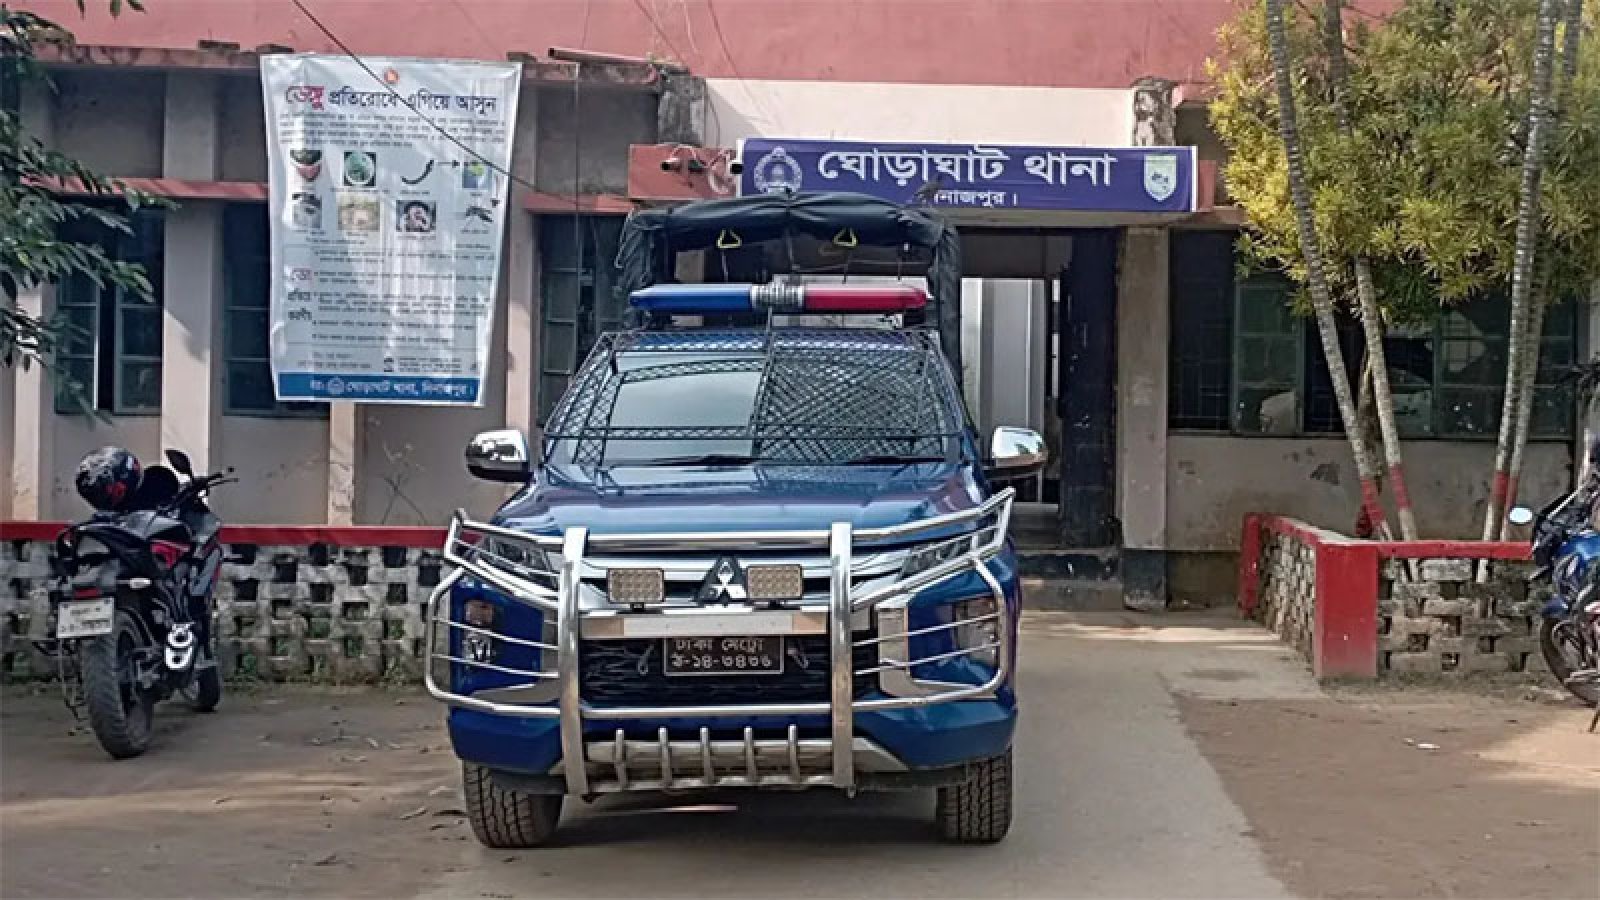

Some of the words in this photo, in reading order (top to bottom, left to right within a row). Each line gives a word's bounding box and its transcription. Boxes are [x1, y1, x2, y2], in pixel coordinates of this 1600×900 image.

[456, 95, 497, 115] আসুন
[818, 144, 1010, 186] ঘোড়াঘাট
[1023, 152, 1117, 186] থানা
[674, 638, 713, 651] ঢাকা
